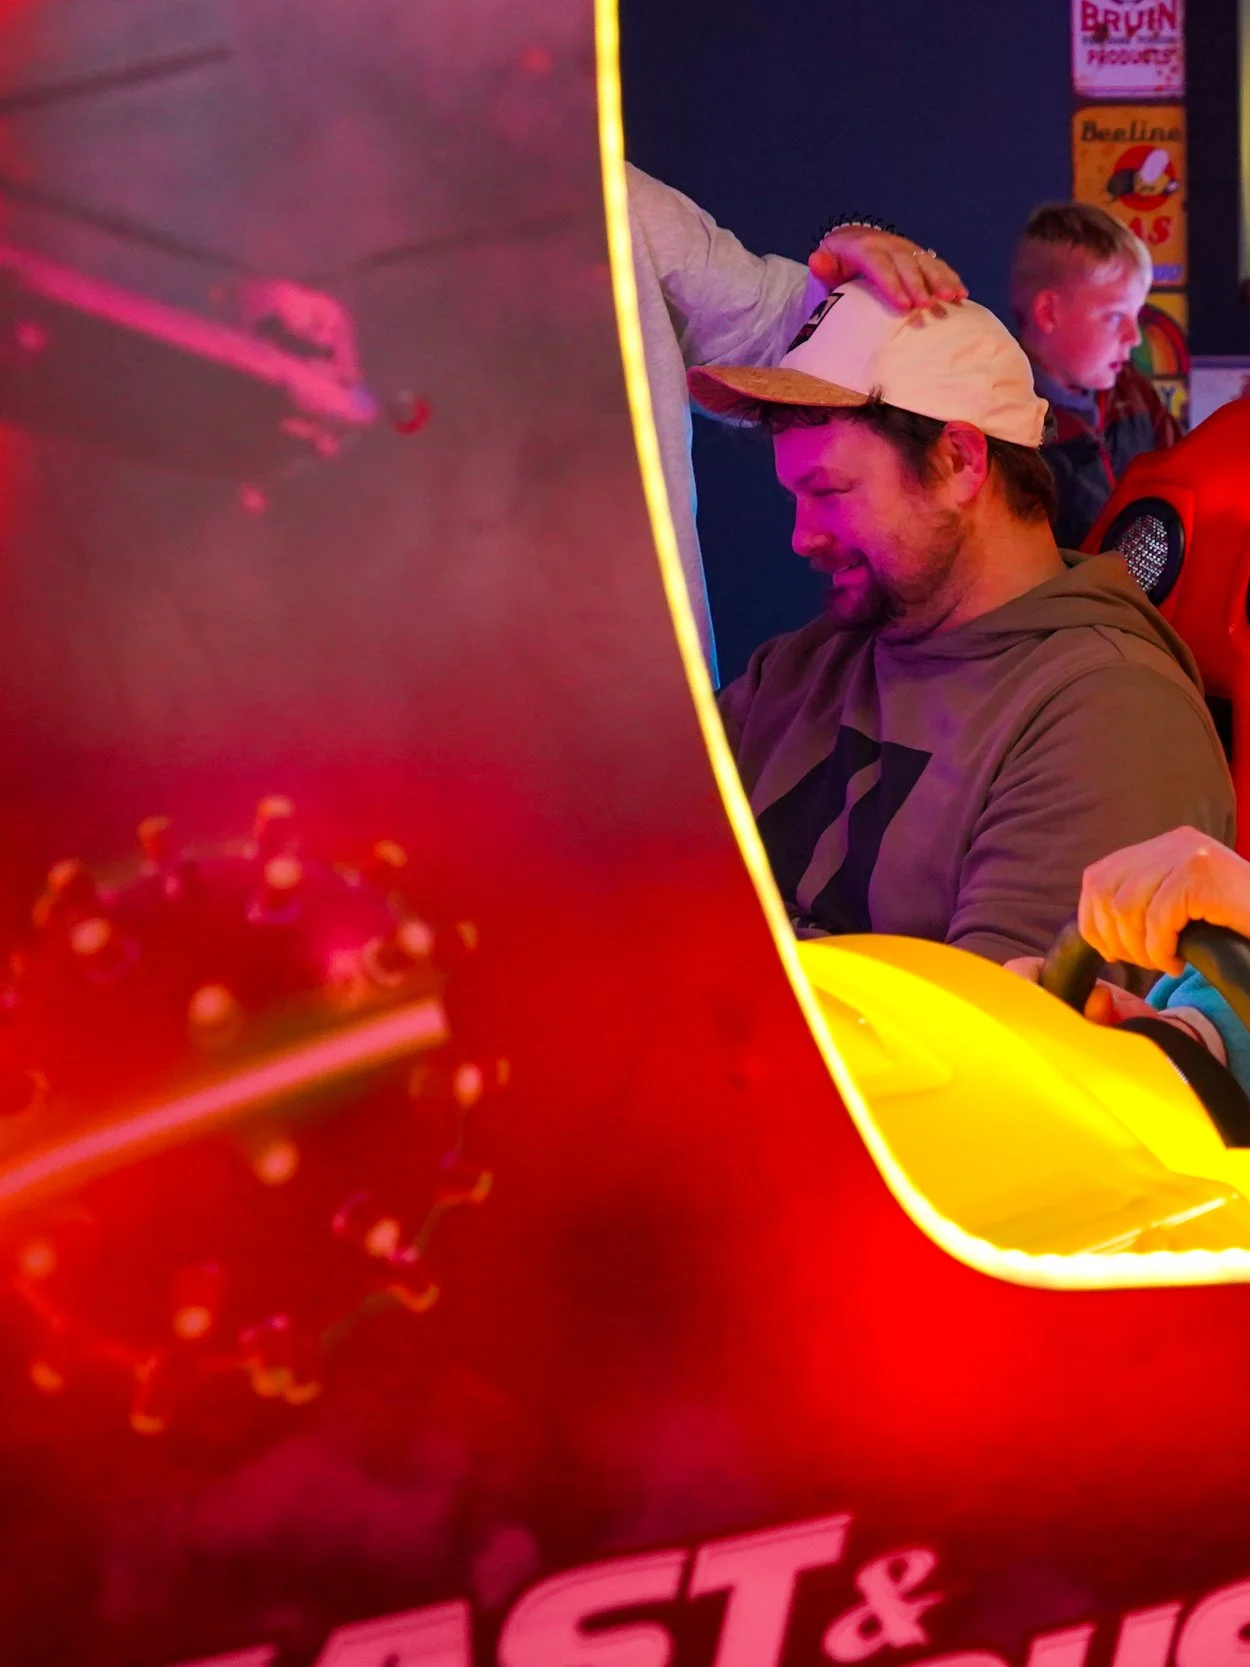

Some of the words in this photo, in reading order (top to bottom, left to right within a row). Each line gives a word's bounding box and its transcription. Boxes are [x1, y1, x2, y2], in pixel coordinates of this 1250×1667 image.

[1081, 0, 1176, 37] BRUIN
[1082, 121, 1181, 141] Beeline
[1129, 215, 1172, 244] AS
[824, 1548, 943, 1661] &
